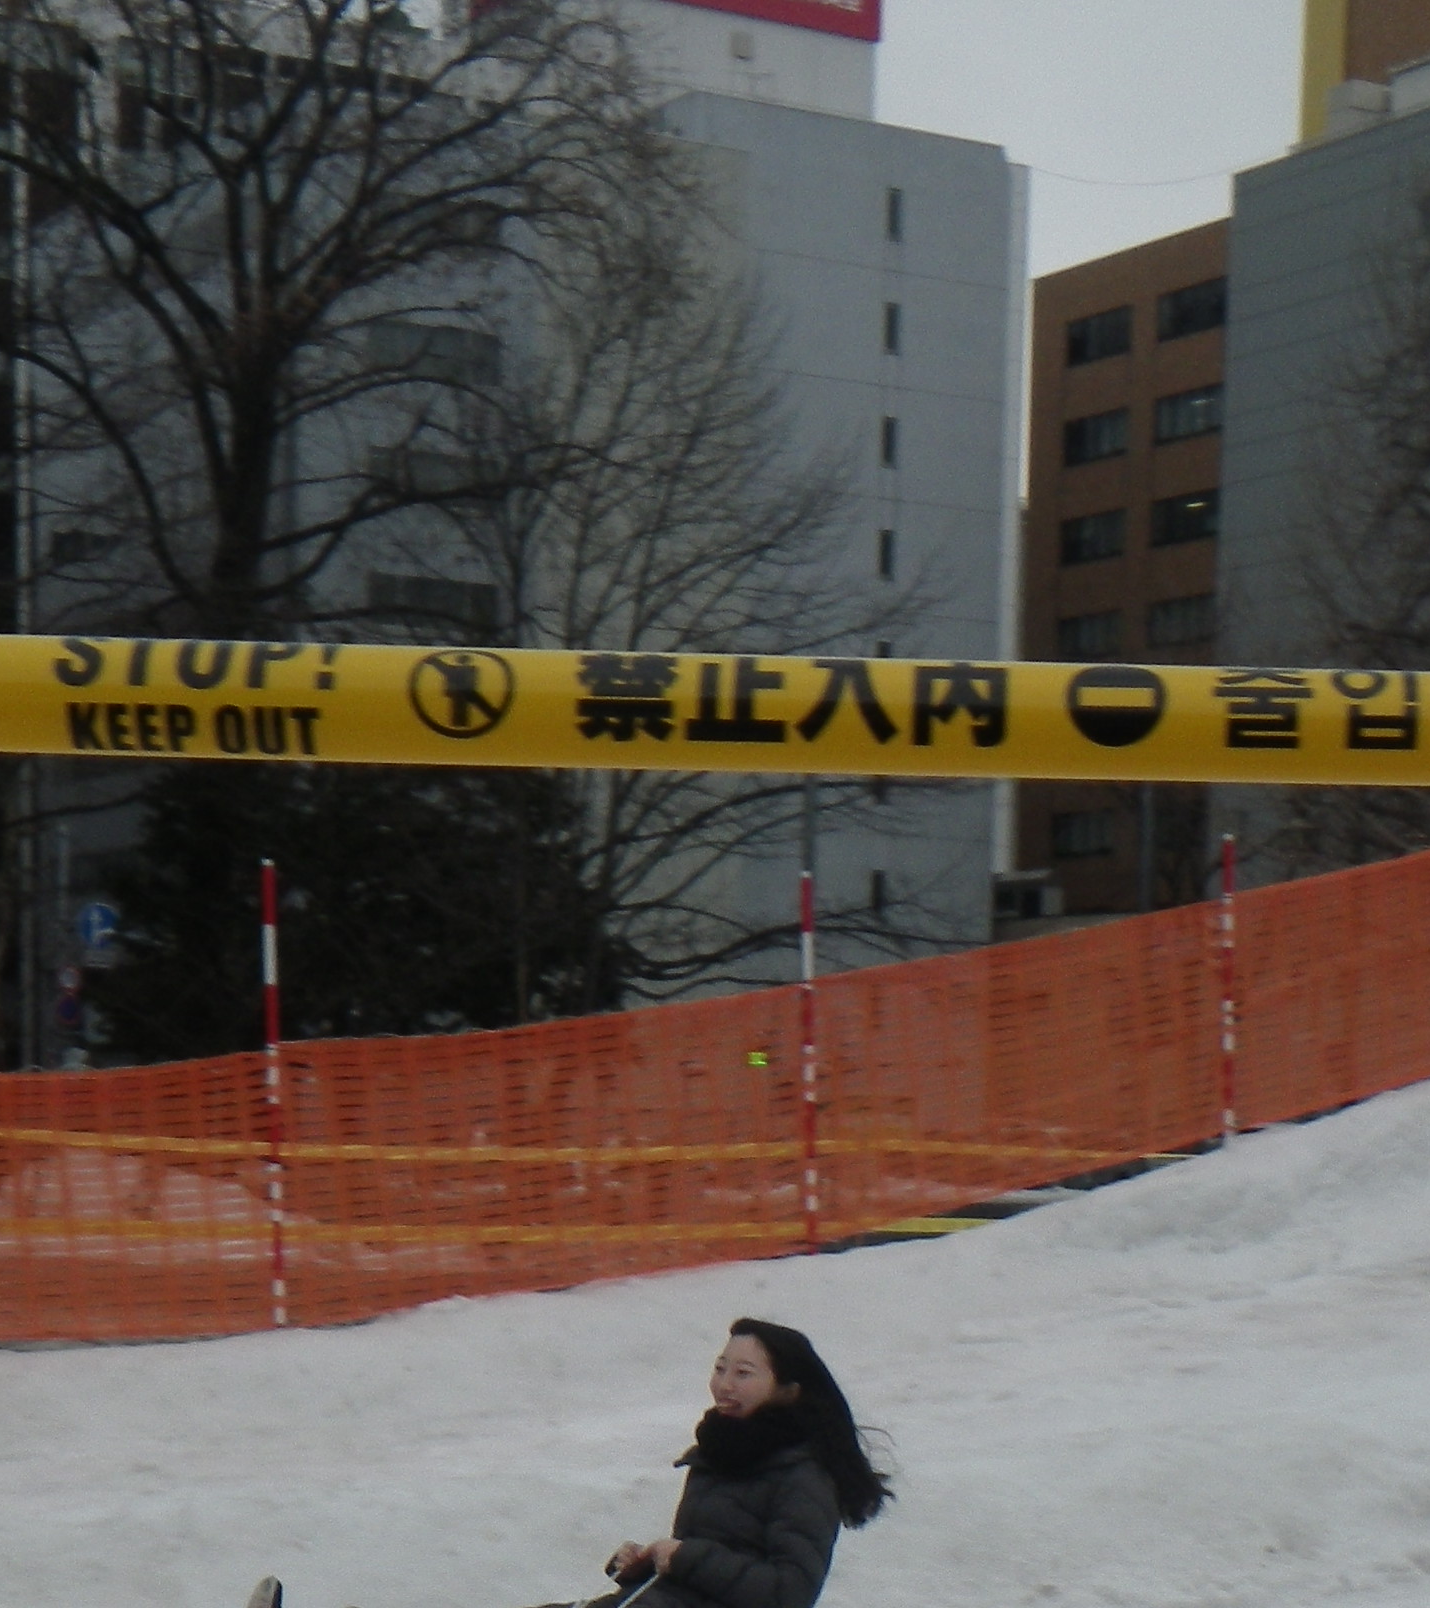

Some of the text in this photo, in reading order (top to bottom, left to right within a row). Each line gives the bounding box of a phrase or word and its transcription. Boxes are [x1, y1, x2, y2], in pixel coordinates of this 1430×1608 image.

[53, 637, 340, 690] STOP!
[576, 654, 1009, 747] 禁止入内
[65, 701, 319, 755] KEEP OUT
